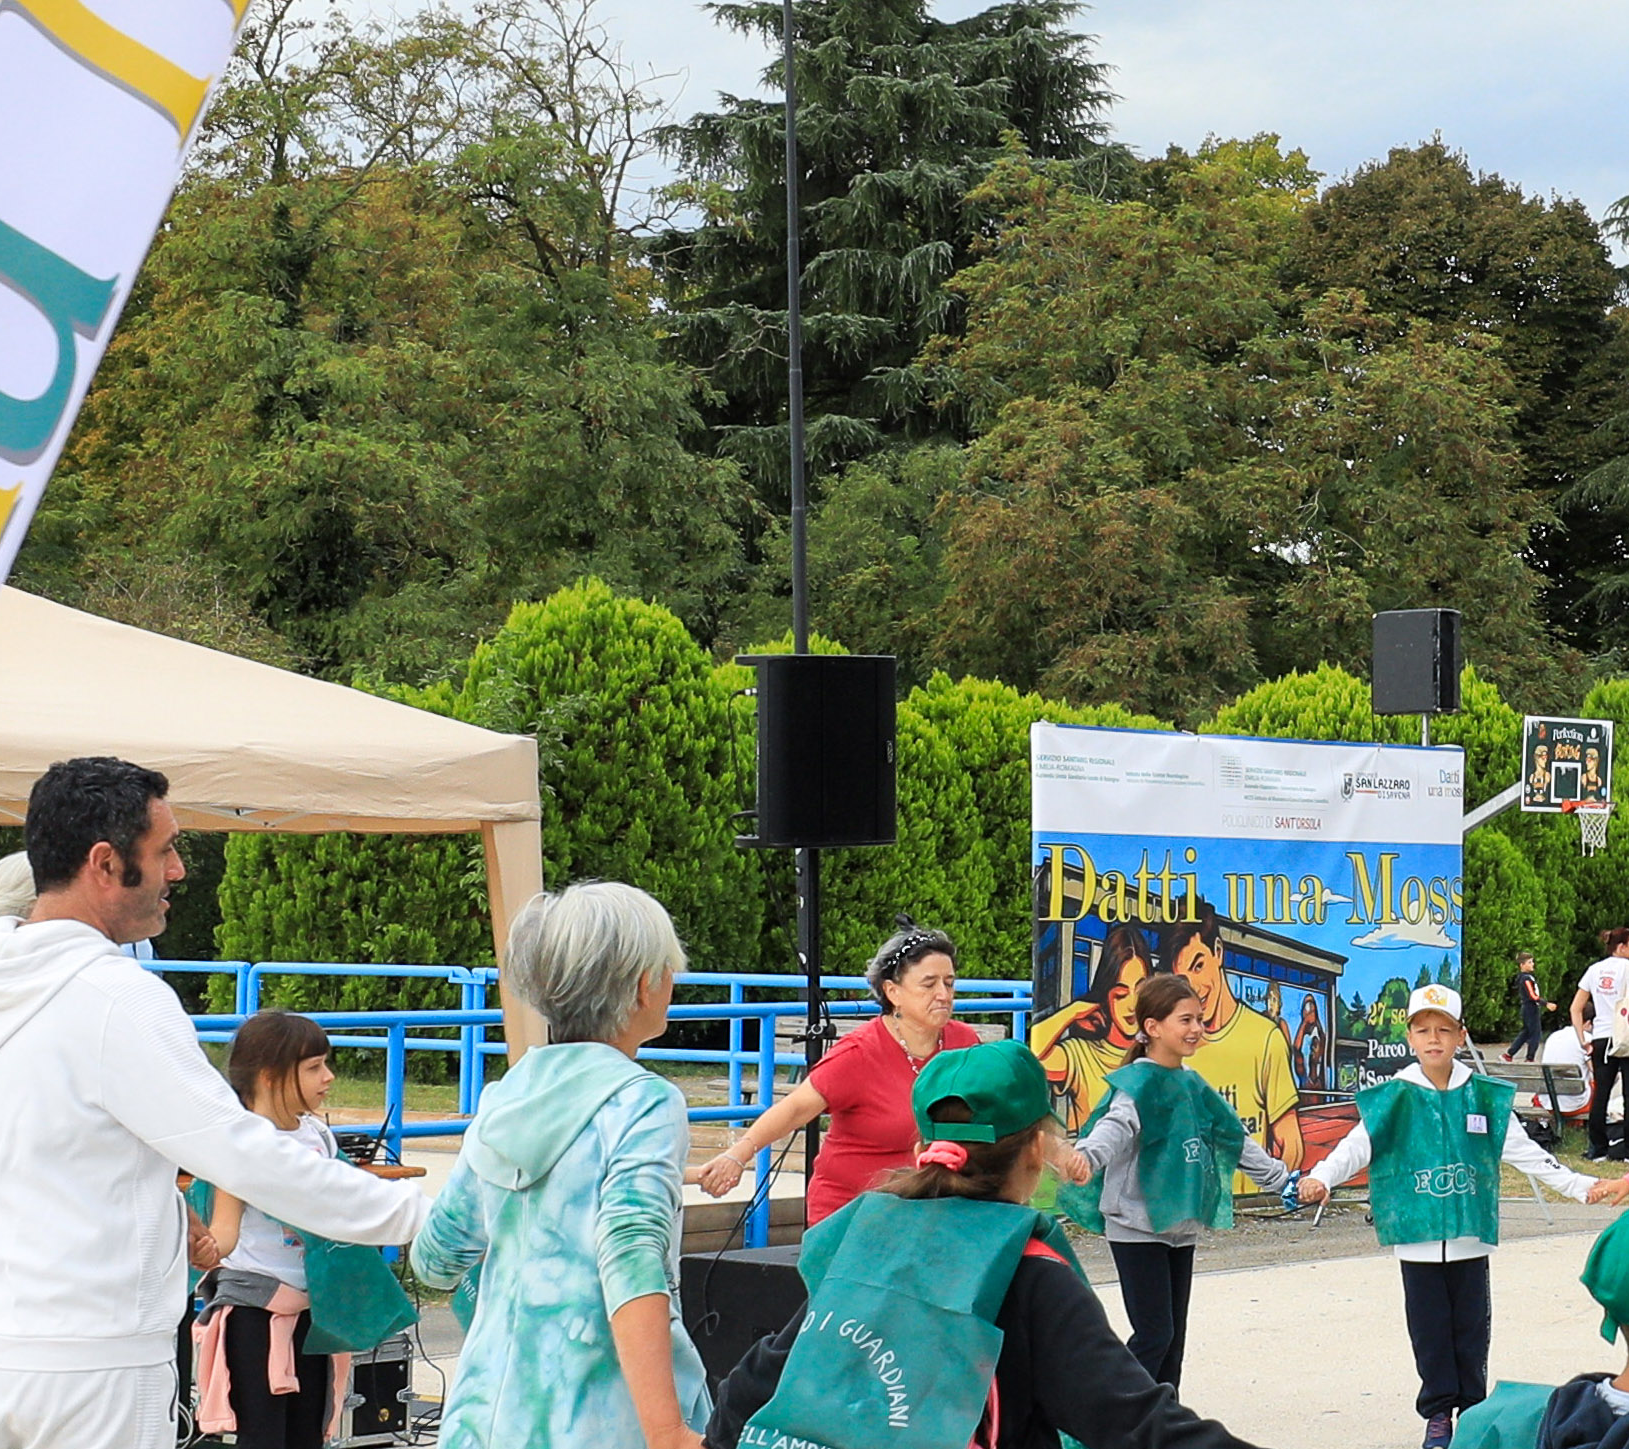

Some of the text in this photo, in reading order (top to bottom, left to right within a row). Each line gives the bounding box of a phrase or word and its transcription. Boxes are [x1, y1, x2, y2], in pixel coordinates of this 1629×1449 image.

[1038, 843, 1202, 924] Datti
[1224, 872, 1327, 925] una
[1368, 1002, 1387, 1026] 27
[1367, 1039, 1406, 1059] Parco
[839, 1318, 910, 1428] GUARDIANI
